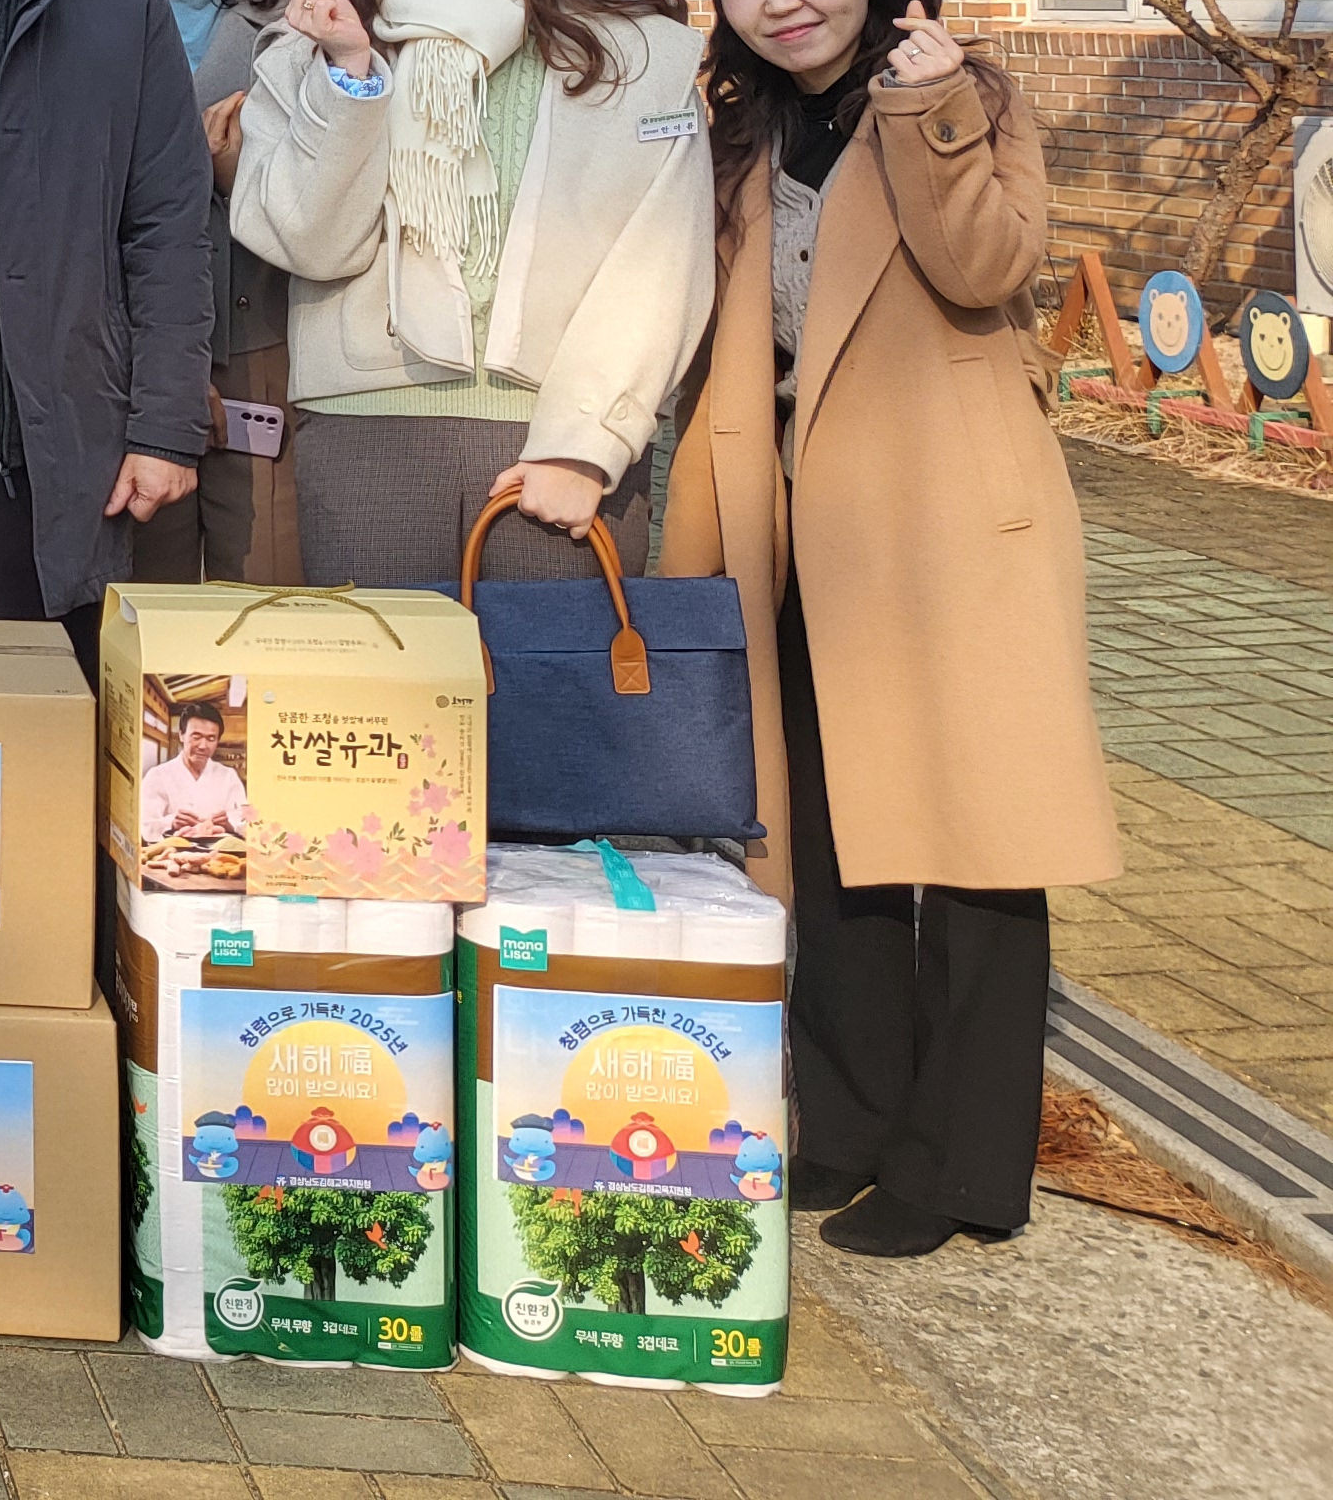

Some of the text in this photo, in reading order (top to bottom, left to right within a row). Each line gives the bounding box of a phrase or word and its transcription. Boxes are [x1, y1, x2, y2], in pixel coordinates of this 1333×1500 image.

[278, 712, 309, 724] 달콤한
[271, 729, 403, 769] 찹쌀유과
[214, 939, 250, 949] mona
[503, 939, 543, 951] mona
[239, 1002, 409, 1056] 청렴으로 가득찬 2025년
[558, 1006, 732, 1062] 청렴으로 가득찬 2025년
[269, 1043, 373, 1076] 새해 福
[589, 1048, 695, 1082] 새해 福
[266, 1078, 378, 1100] 많이 받으세요!
[586, 1082, 699, 1106] 많이 받으세요!
[224, 1298, 253, 1311] 친환경
[515, 1302, 550, 1317] 친환경
